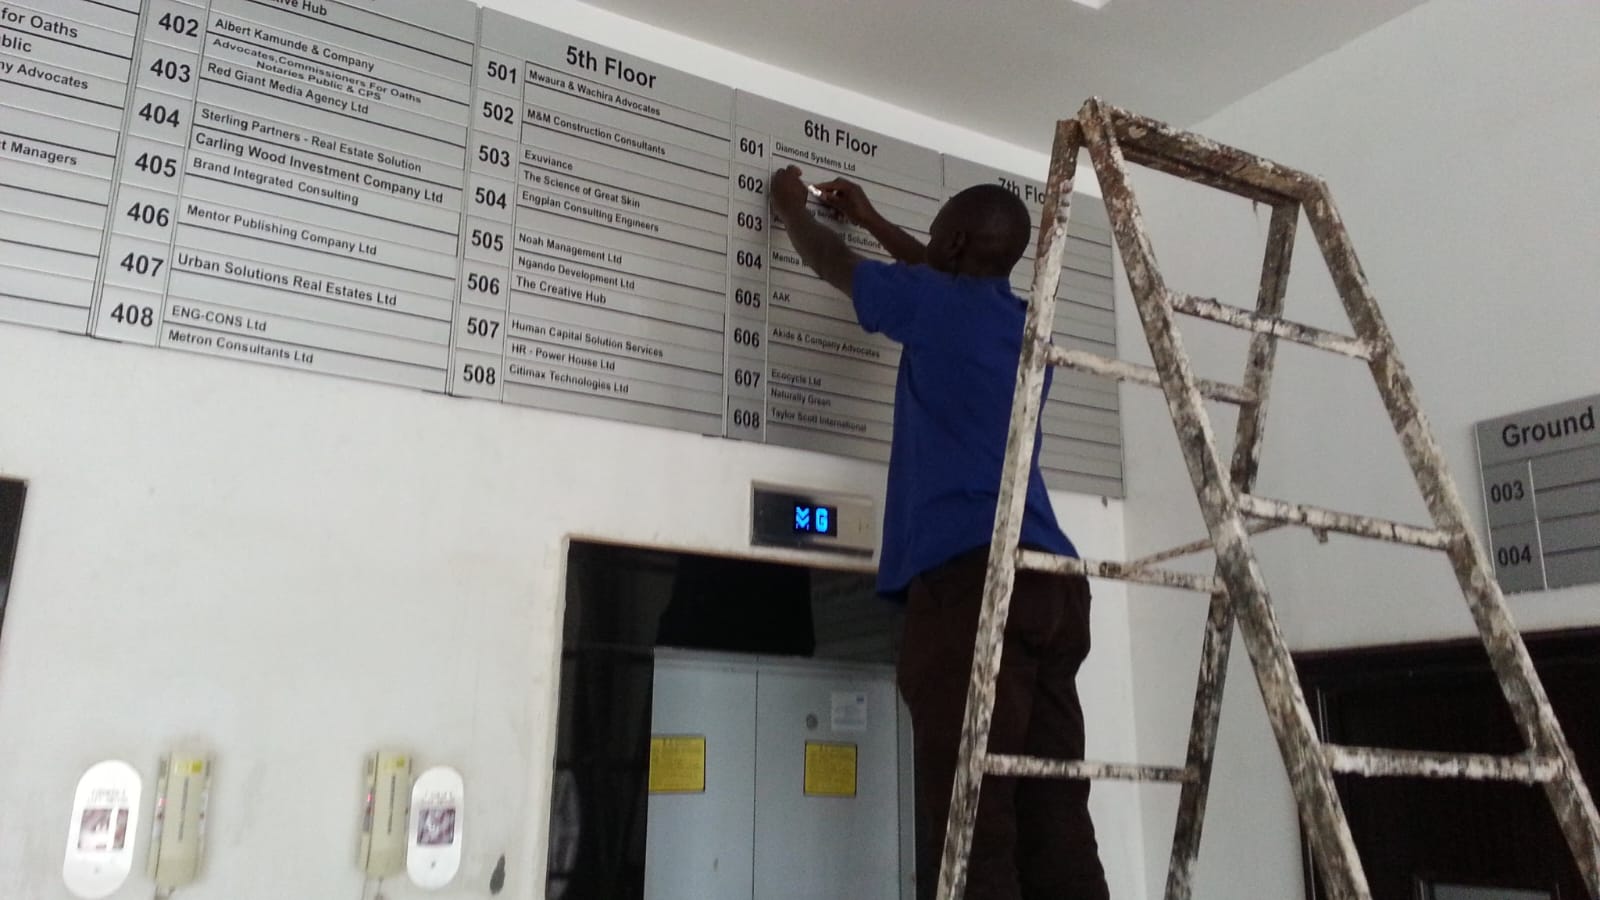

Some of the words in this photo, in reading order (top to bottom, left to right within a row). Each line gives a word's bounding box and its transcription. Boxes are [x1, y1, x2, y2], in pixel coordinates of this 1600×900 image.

[302, 0, 327, 16] Hub
[1, 7, 25, 24] for
[30, 15, 78, 38] Oaths
[158, 12, 199, 38] 402
[215, 18, 251, 36] Albert
[254, 28, 308, 52] Kamunde
[311, 44, 319, 55] &
[323, 48, 375, 72] Company
[17, 64, 88, 89] Advocates
[150, 58, 191, 83] 403
[487, 61, 517, 84] 501
[566, 45, 597, 72] 5th
[605, 56, 657, 89] Floor
[207, 62, 231, 78] Red
[235, 70, 266, 87] Giant
[269, 79, 303, 97] Media
[305, 89, 348, 110] Agency
[351, 101, 369, 114] Ltd
[256, 60, 304, 80] Notaries
[307, 74, 342, 90] Public
[346, 86, 354, 94] &
[358, 87, 381, 101] CPS
[370, 82, 387, 94] For
[390, 88, 422, 103] Oaths
[529, 69, 566, 88] Mwaura
[568, 80, 574, 90] &
[577, 83, 613, 102] Wachira
[615, 95, 661, 116] Advocates
[138, 103, 180, 128] 404
[483, 101, 514, 124] 502
[201, 108, 249, 131] Sterling
[251, 120, 301, 142] Partners
[311, 136, 336, 151] Real
[340, 143, 374, 160] Estate
[377, 153, 421, 172] Solution
[527, 108, 551, 123] M&M
[553, 116, 612, 141] Construction
[614, 133, 666, 155] Consultants
[804, 120, 830, 143] 6th
[836, 129, 878, 157] Floor
[11, 141, 77, 166] Managers
[478, 145, 510, 167] 503
[740, 137, 763, 157] 601
[776, 142, 809, 159] Diamond
[811, 153, 842, 169] Systems
[844, 161, 856, 171] Ltd
[135, 152, 177, 178] 405
[195, 132, 244, 157] Carling
[248, 145, 286, 164] Wood
[290, 156, 359, 182] Investment
[363, 174, 421, 199] Company
[424, 189, 443, 203] Ltd
[524, 150, 573, 170] Exuviance
[193, 157, 230, 175] Brand
[233, 166, 293, 189] Integrated
[298, 182, 359, 206] Consulting
[524, 170, 541, 183] The
[544, 175, 580, 194] Science
[583, 186, 592, 196] of
[594, 188, 619, 203] Great
[621, 195, 640, 209] Skin
[738, 174, 763, 194] 602
[475, 186, 507, 209] 504
[127, 202, 170, 227] 406
[522, 190, 561, 209] Engplan
[563, 200, 612, 222] Consulting
[615, 214, 659, 232] Engineers
[737, 212, 762, 231] 603
[187, 204, 231, 223] Mentor
[234, 214, 297, 240] Publishing
[301, 229, 355, 252] Company
[359, 242, 377, 255] Ltd
[471, 229, 504, 252] 505
[519, 232, 544, 247] Noah
[547, 239, 605, 261] Management
[607, 253, 622, 264] Ltd
[737, 251, 762, 270] 604
[120, 252, 164, 277] 407
[518, 256, 555, 273] Ngando
[558, 265, 618, 286] Development
[620, 279, 635, 290] Ltd
[178, 252, 219, 272] Urban
[225, 261, 288, 285] Solutions
[293, 275, 322, 292] Real
[326, 282, 373, 301] Estates
[377, 291, 397, 306] Ltd
[468, 273, 500, 295] 506
[516, 275, 536, 289] The
[539, 281, 583, 299] Creative
[585, 292, 606, 304] Hub
[735, 288, 760, 308] 605
[773, 291, 790, 302] AAK
[110, 302, 154, 327] 408
[247, 317, 267, 332] Ltd
[467, 317, 500, 339] 507
[511, 319, 546, 335] Human
[549, 327, 582, 344] Capital
[585, 333, 622, 350] Solution
[625, 340, 664, 358] Services
[734, 328, 760, 348] 606
[169, 329, 212, 347] Metron
[216, 337, 290, 359] Consultants
[294, 350, 314, 364] Ltd
[511, 343, 526, 355] HR
[535, 347, 565, 361] Power
[568, 355, 598, 368] House
[600, 360, 615, 371] Ltd
[797, 333, 802, 341] &
[805, 334, 840, 351] Company
[841, 343, 880, 358] Advocates
[463, 364, 496, 385] 508
[509, 364, 545, 379] Citimax
[550, 372, 611, 391] Technologies
[613, 382, 629, 393] Ltd
[735, 369, 760, 388] 607
[809, 375, 821, 386] Ltd
[771, 388, 806, 404] Naturally
[734, 409, 760, 429] 608
[820, 416, 867, 433] International
[1502, 406, 1595, 447] Ground
[1491, 480, 1525, 503] 003
[815, 507, 828, 532] G
[1498, 544, 1532, 567] 004
